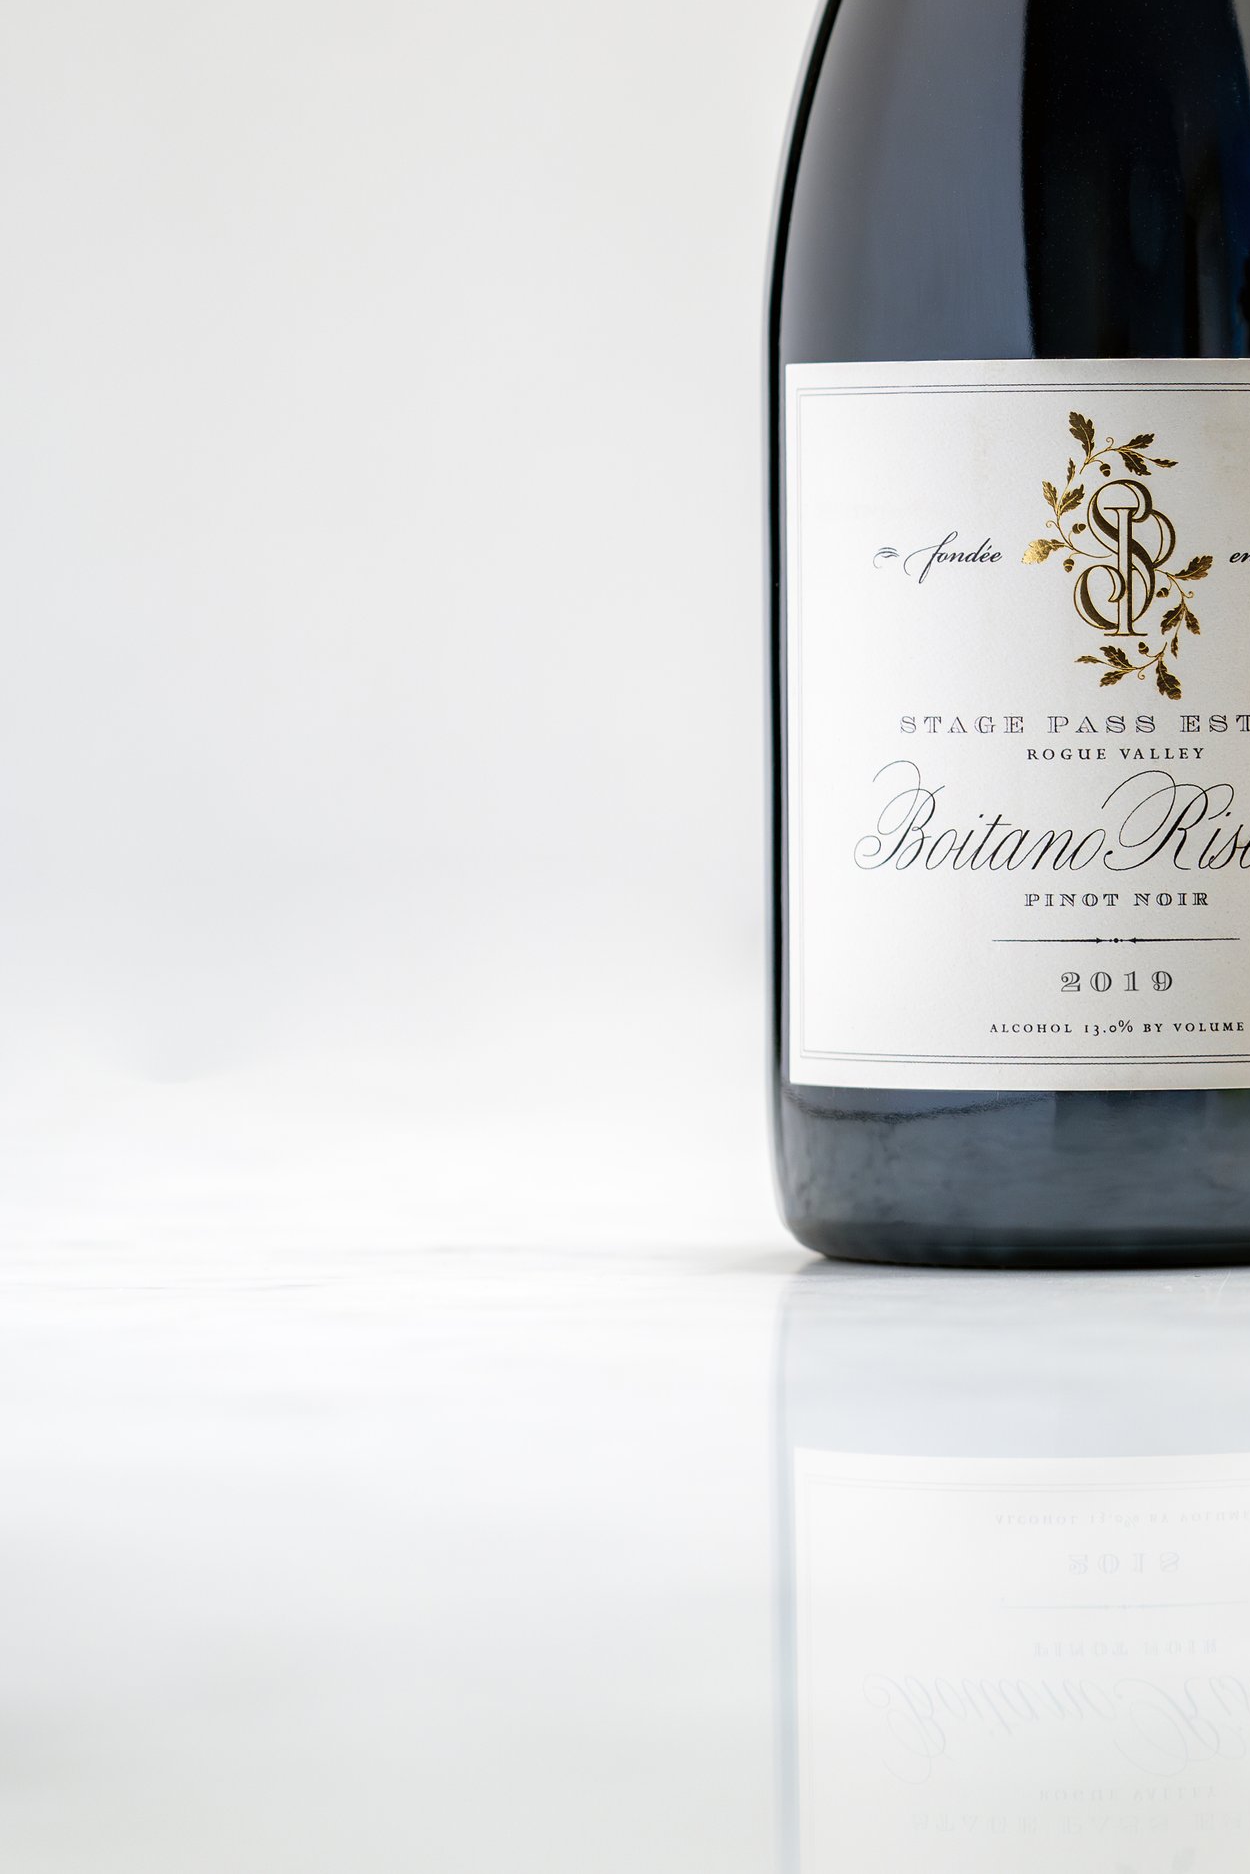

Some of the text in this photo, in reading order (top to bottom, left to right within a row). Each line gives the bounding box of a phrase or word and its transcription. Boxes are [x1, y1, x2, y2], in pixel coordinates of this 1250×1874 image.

[902, 530, 1004, 585] fondée
[899, 714, 1024, 735] STAGE
[1046, 713, 1158, 734] PASS
[1026, 746, 1205, 761] ROGUE VALLEY
[853, 759, 1107, 872] Boitano
[1023, 891, 1209, 908] PINOT NOIR
[1060, 970, 1174, 993] 2019
[989, 1019, 1245, 1037] ALCOHOL 13.0% BY VOLUME
